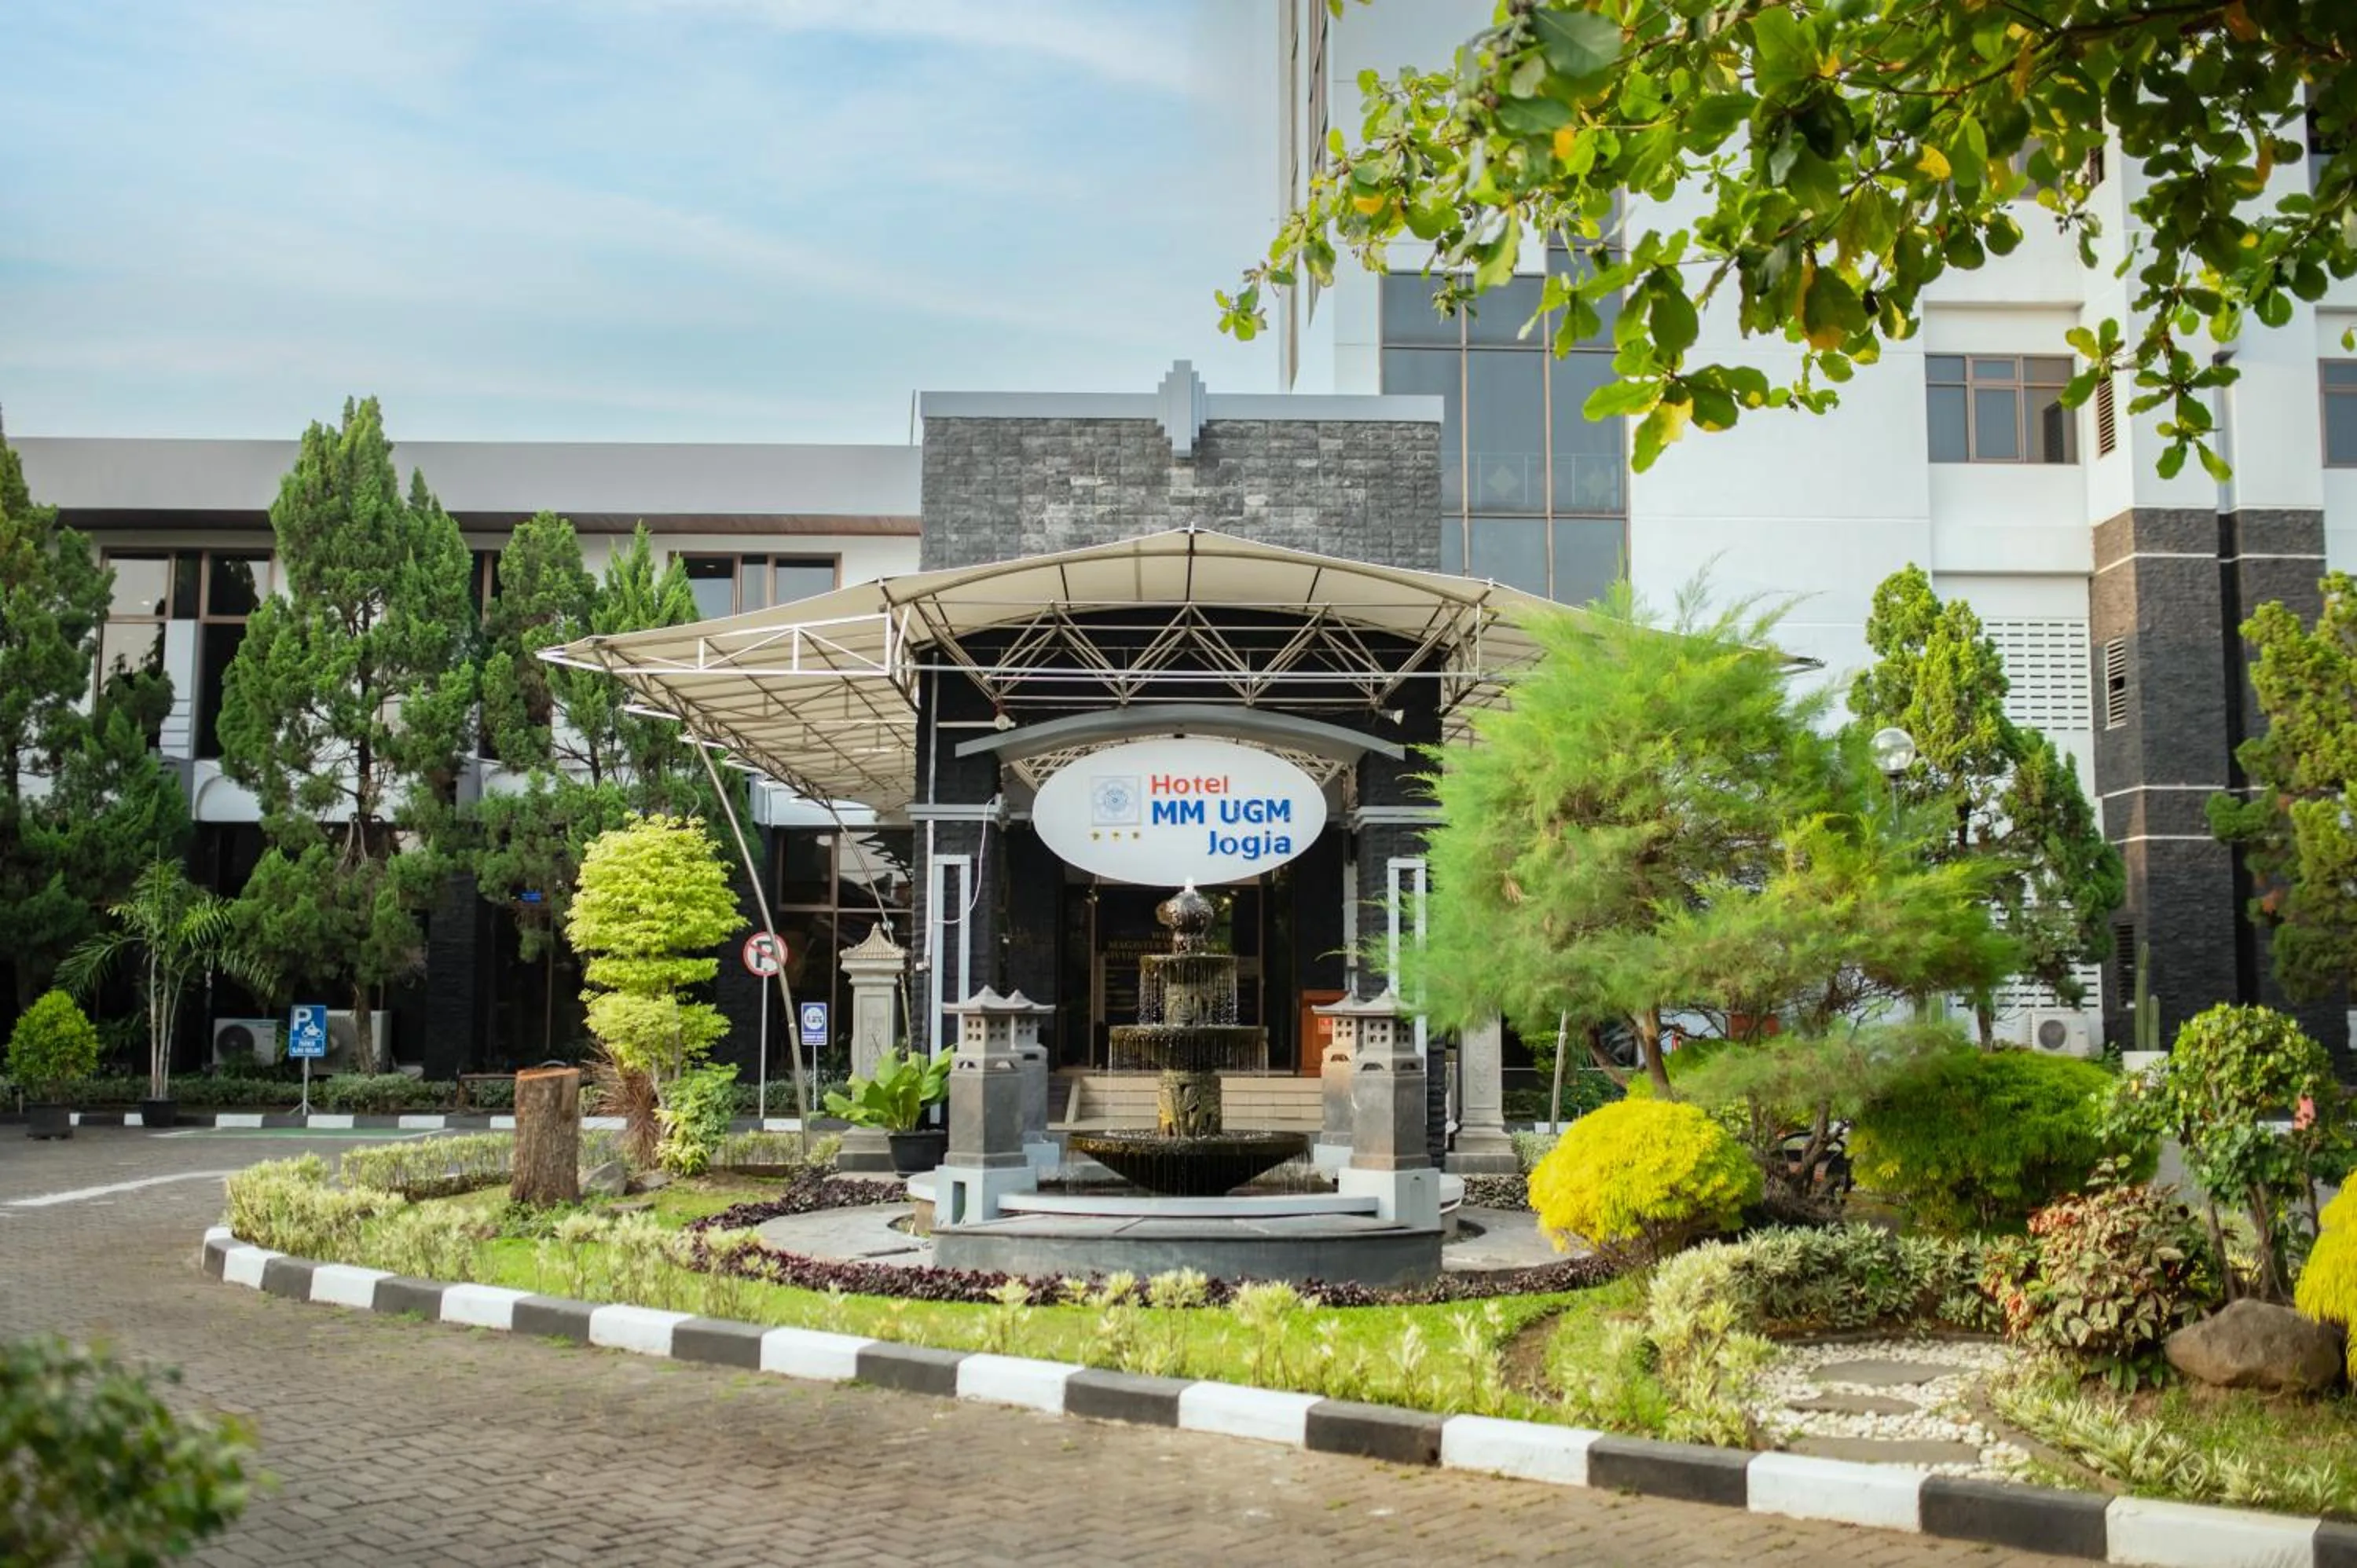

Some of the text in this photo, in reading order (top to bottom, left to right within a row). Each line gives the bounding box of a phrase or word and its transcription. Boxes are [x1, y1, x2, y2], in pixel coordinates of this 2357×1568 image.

[1150, 775, 1229, 794] Hotel
[1152, 799, 1291, 825] MM UGM
[1208, 830, 1291, 859] Jogja
[294, 1008, 312, 1031] P
